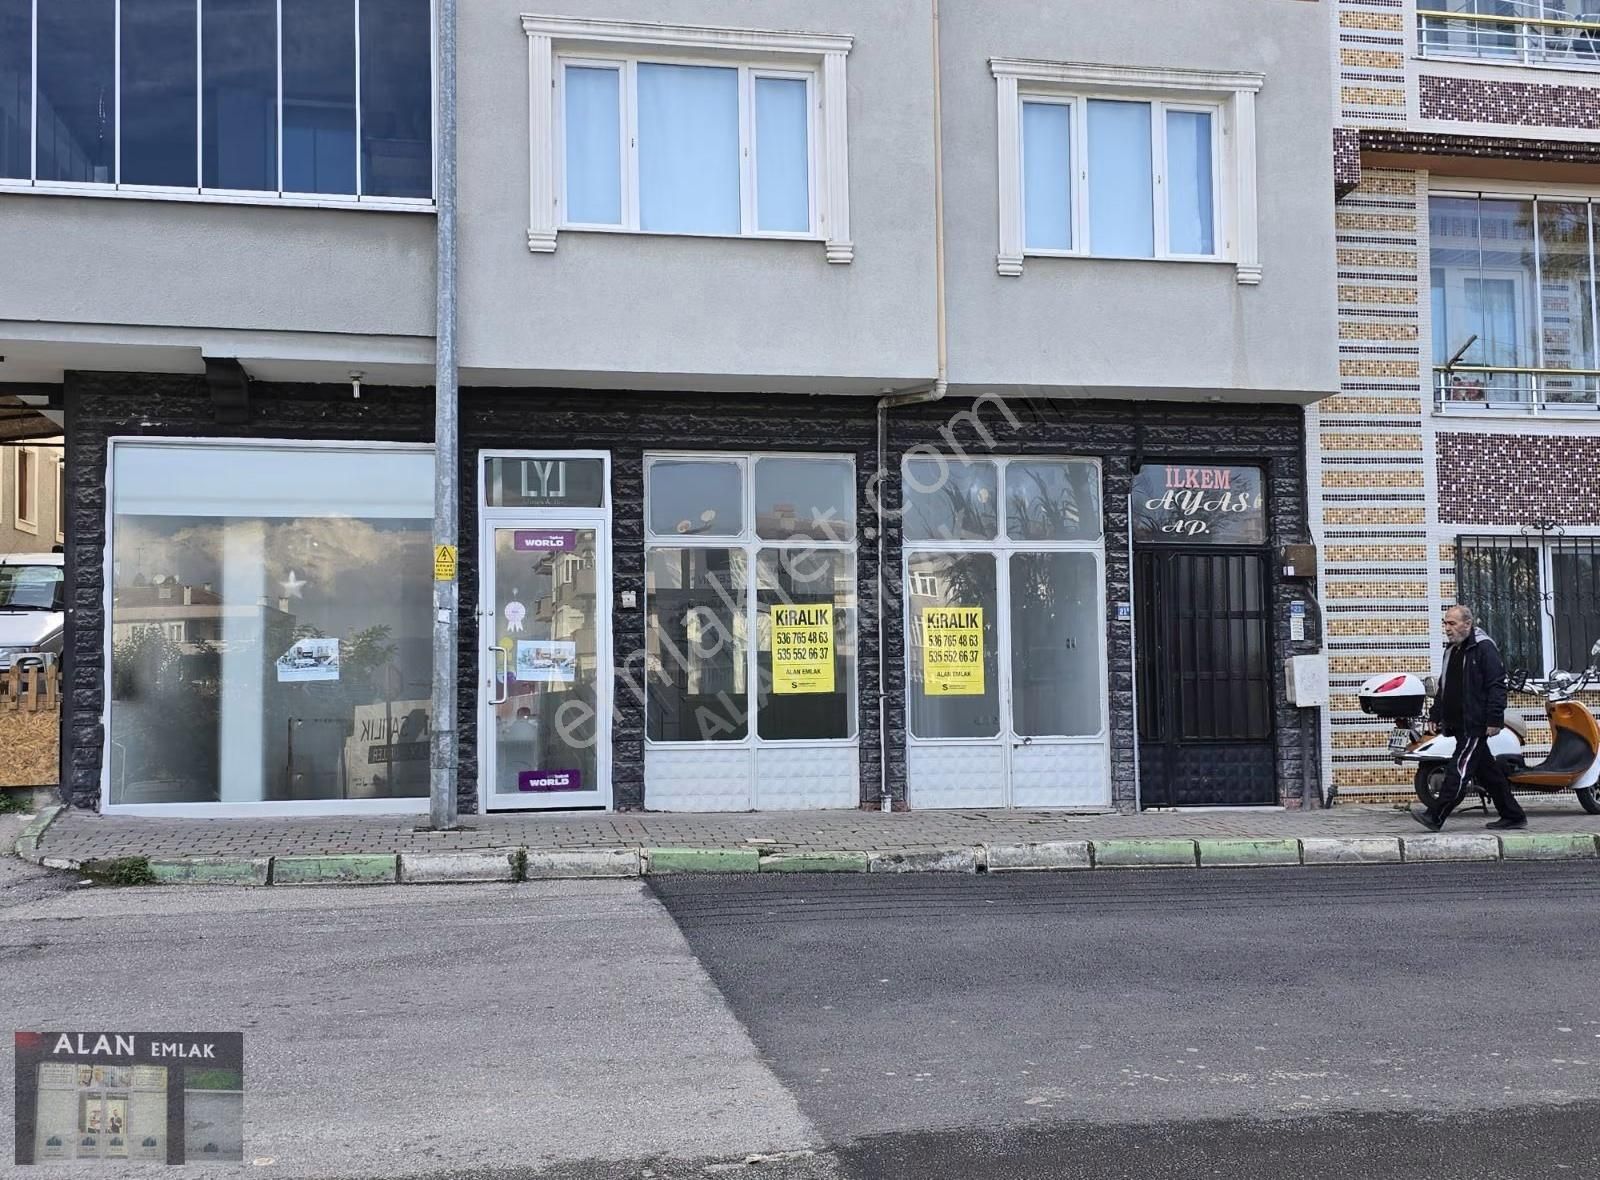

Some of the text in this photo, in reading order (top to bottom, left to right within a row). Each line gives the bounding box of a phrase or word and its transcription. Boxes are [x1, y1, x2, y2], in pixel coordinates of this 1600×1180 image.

[777, 632, 828, 644] 536 765 48 63
[928, 635, 978, 647] 536 765 48 63
[777, 648, 828, 660] 535 552 66 37
[928, 651, 978, 663] 535 552 66 37
[529, 778, 569, 787] WORLD
